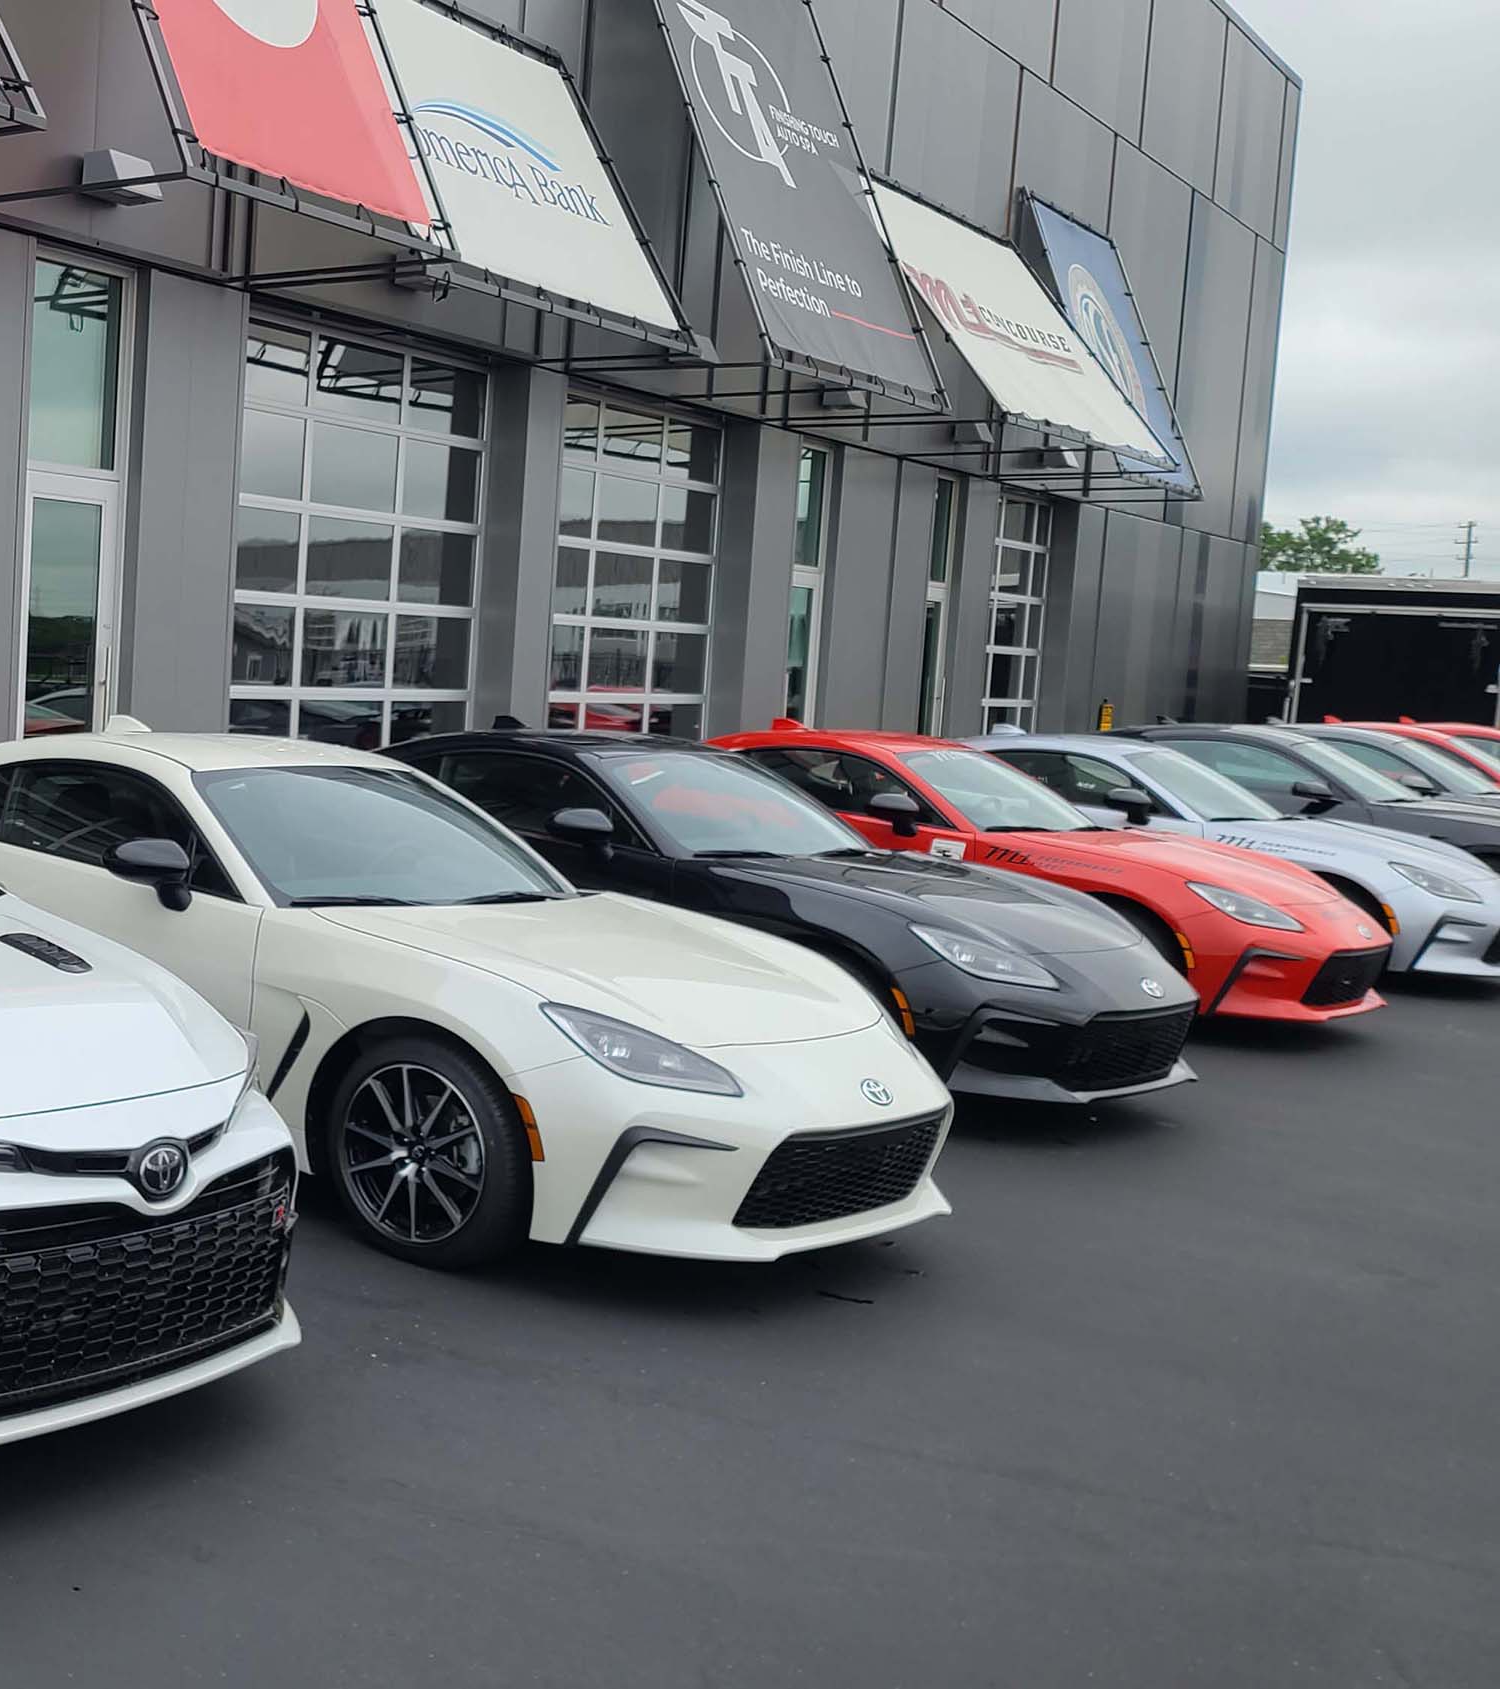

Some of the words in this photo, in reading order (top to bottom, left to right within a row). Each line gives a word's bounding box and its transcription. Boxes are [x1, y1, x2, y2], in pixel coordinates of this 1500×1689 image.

[768, 104, 810, 136] FINISHING
[807, 123, 840, 149] TOUCH
[776, 123, 801, 148] AUTO
[799, 135, 820, 157] SPA
[527, 162, 612, 227] Bank
[740, 226, 772, 262] The
[769, 241, 815, 281] Finish
[812, 259, 847, 293] Line
[844, 273, 862, 299] to
[756, 266, 832, 319] Perfection
[978, 305, 1072, 353] CONCOURSE
